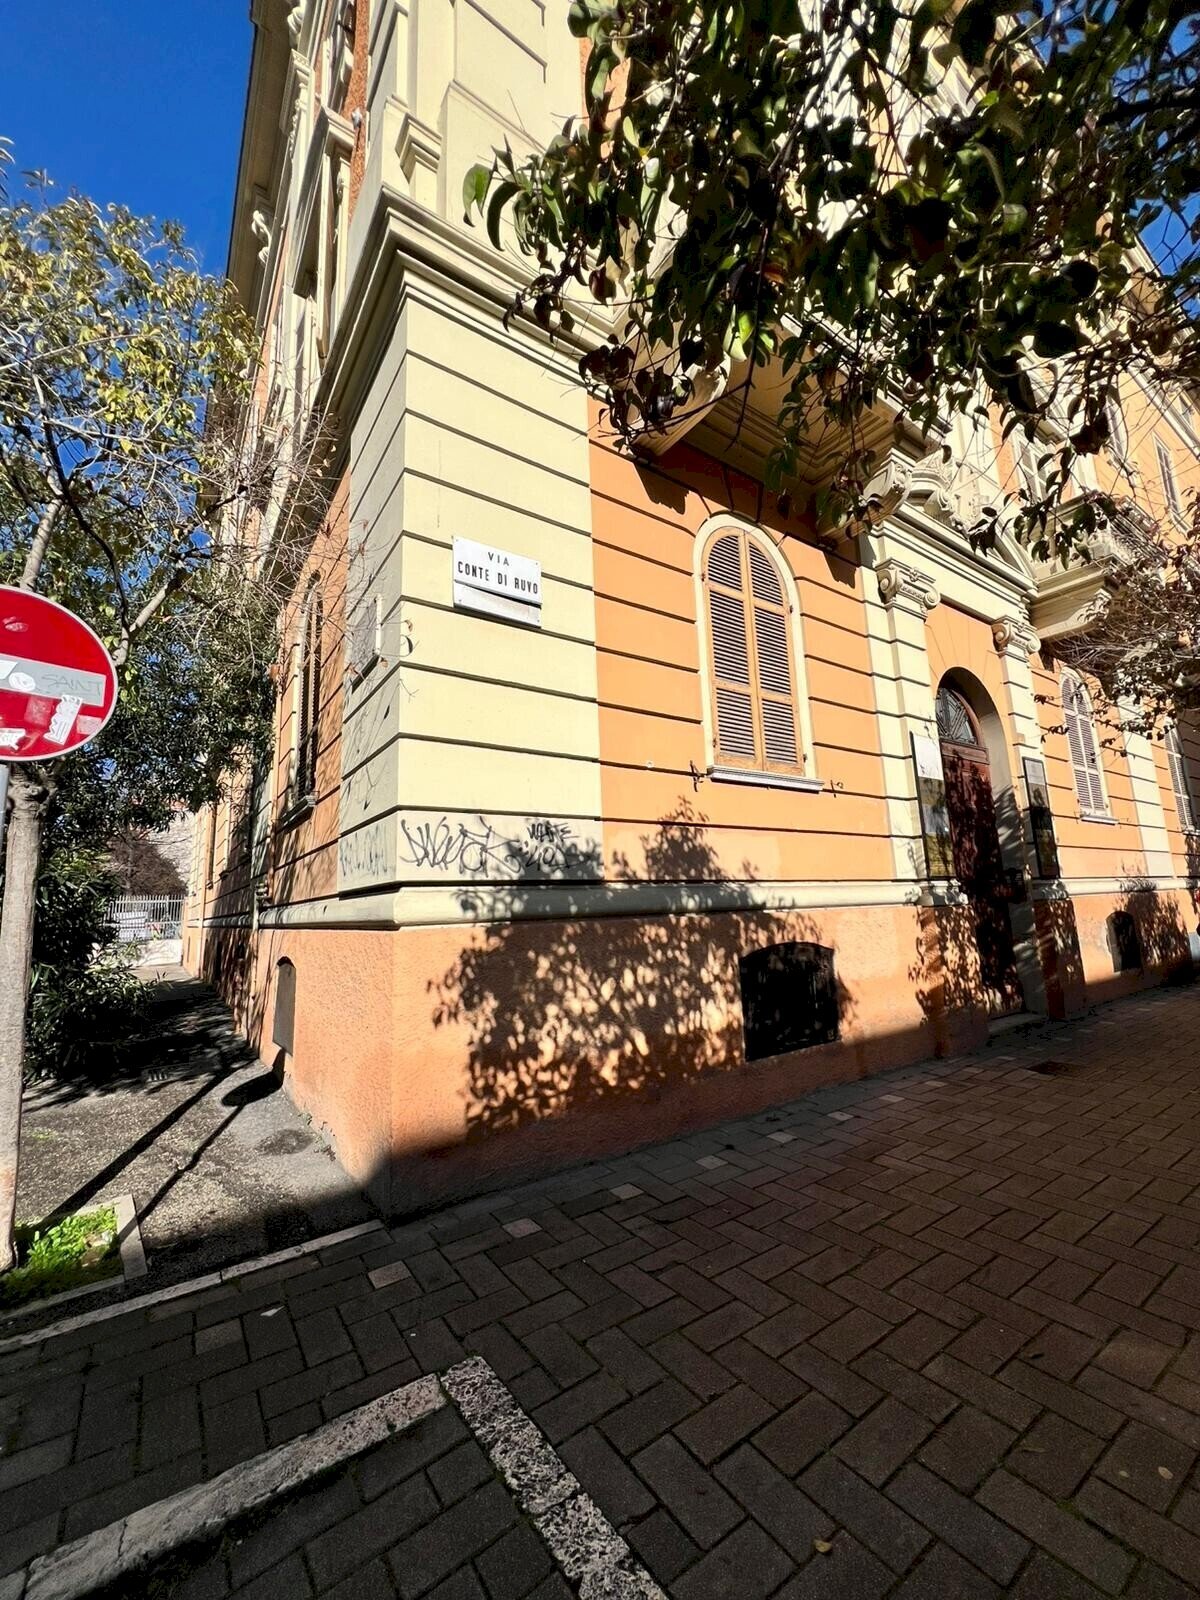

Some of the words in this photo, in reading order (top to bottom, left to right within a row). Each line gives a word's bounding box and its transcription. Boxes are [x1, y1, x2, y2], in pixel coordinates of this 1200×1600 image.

[488, 551, 510, 566] VIA
[457, 561, 490, 581] CONTE
[497, 572, 508, 586] DI
[514, 577, 538, 594] RUVO
